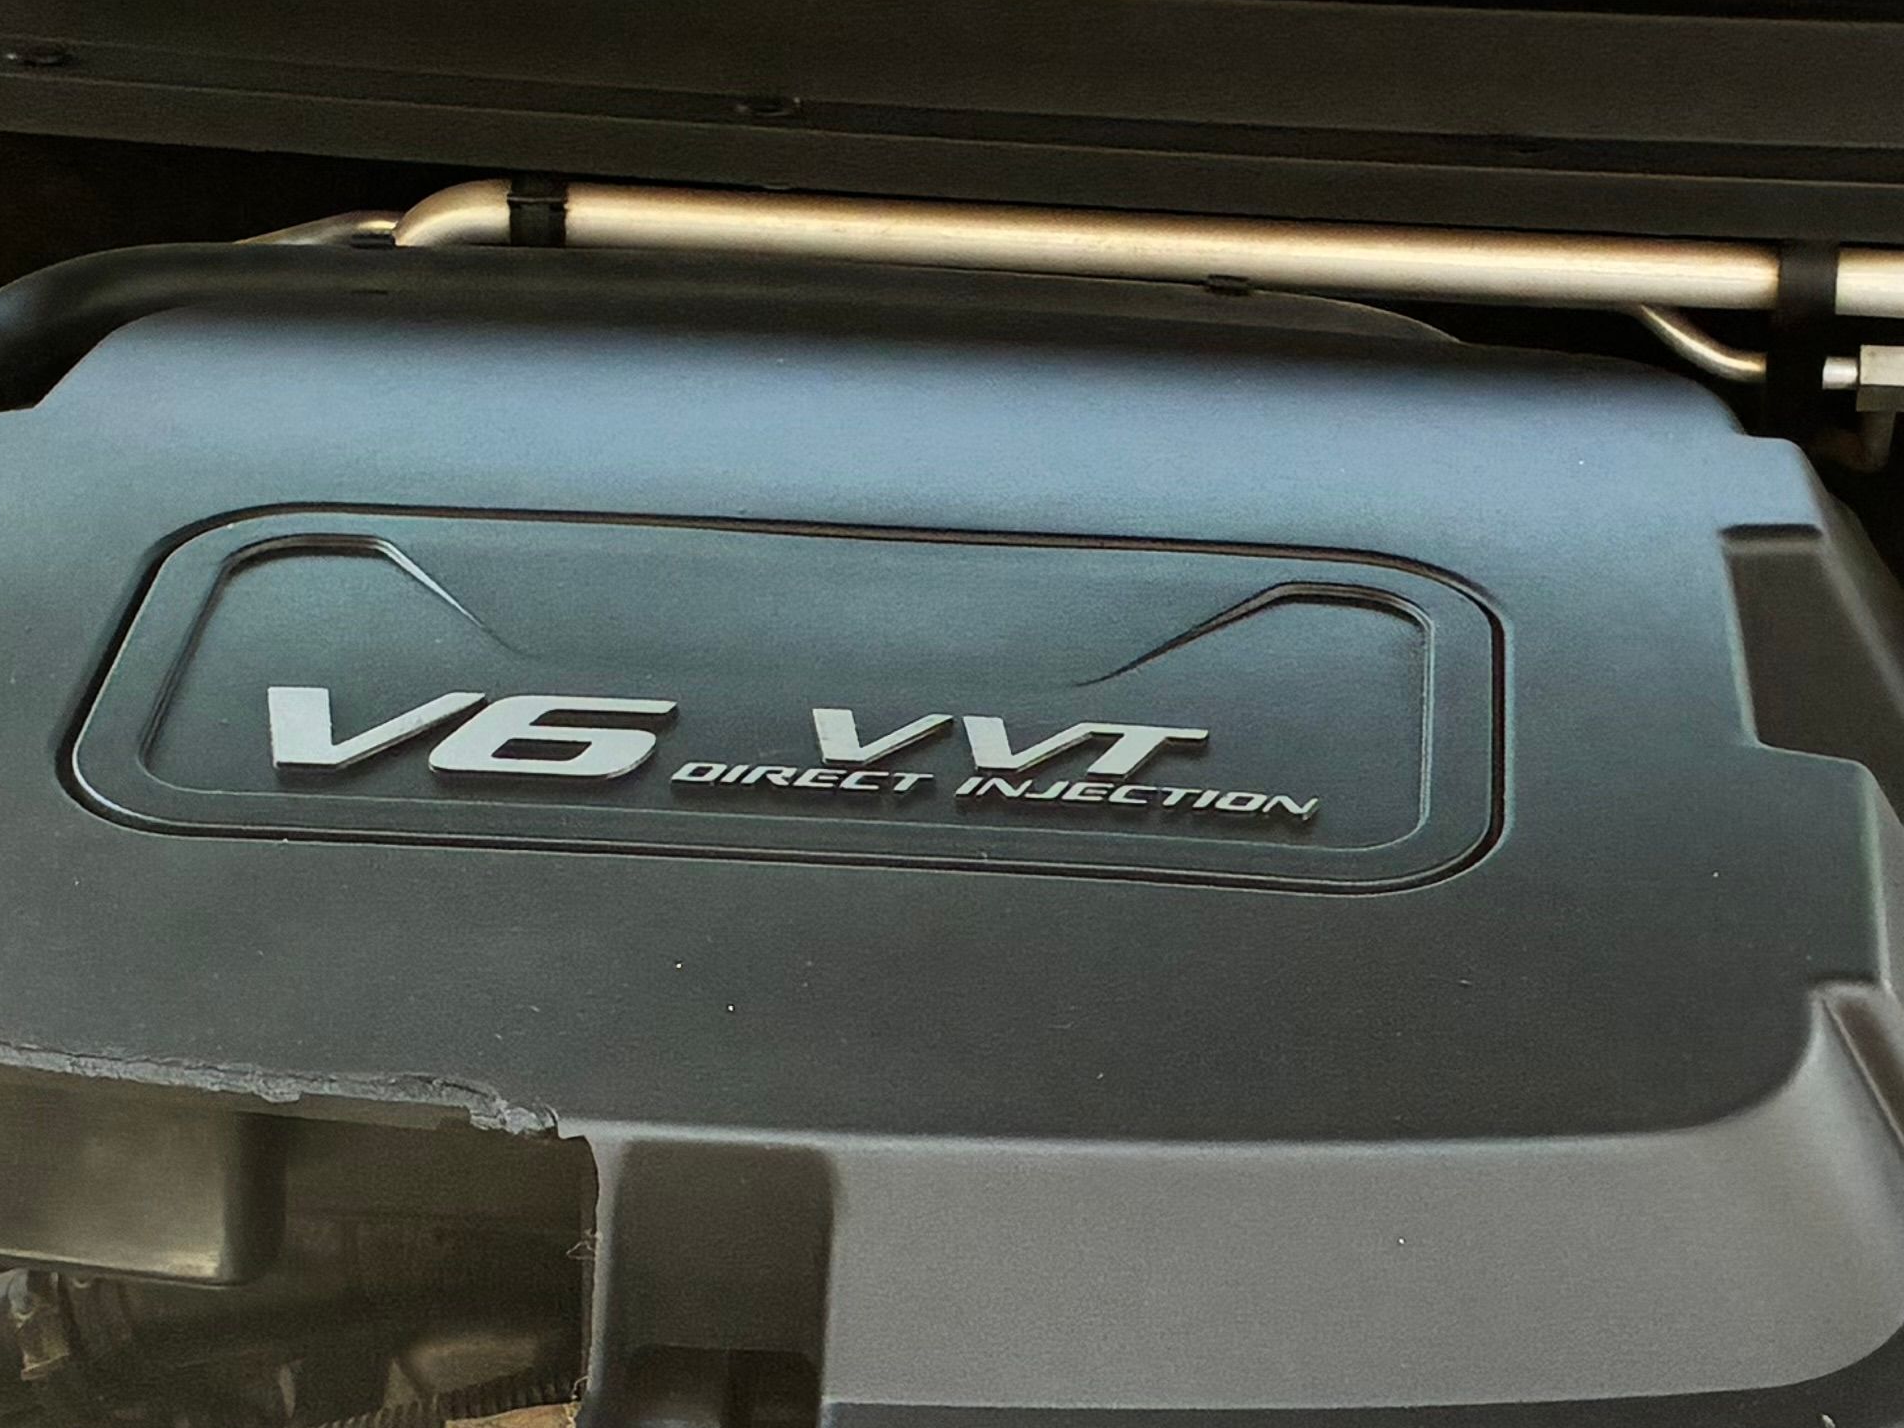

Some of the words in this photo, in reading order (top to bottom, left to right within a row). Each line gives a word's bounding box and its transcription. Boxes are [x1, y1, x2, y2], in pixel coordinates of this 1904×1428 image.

[266, 685, 678, 780] V6
[810, 708, 1210, 779] VVT
[669, 761, 936, 794] DIRECT
[955, 775, 1321, 822] INJECTION
